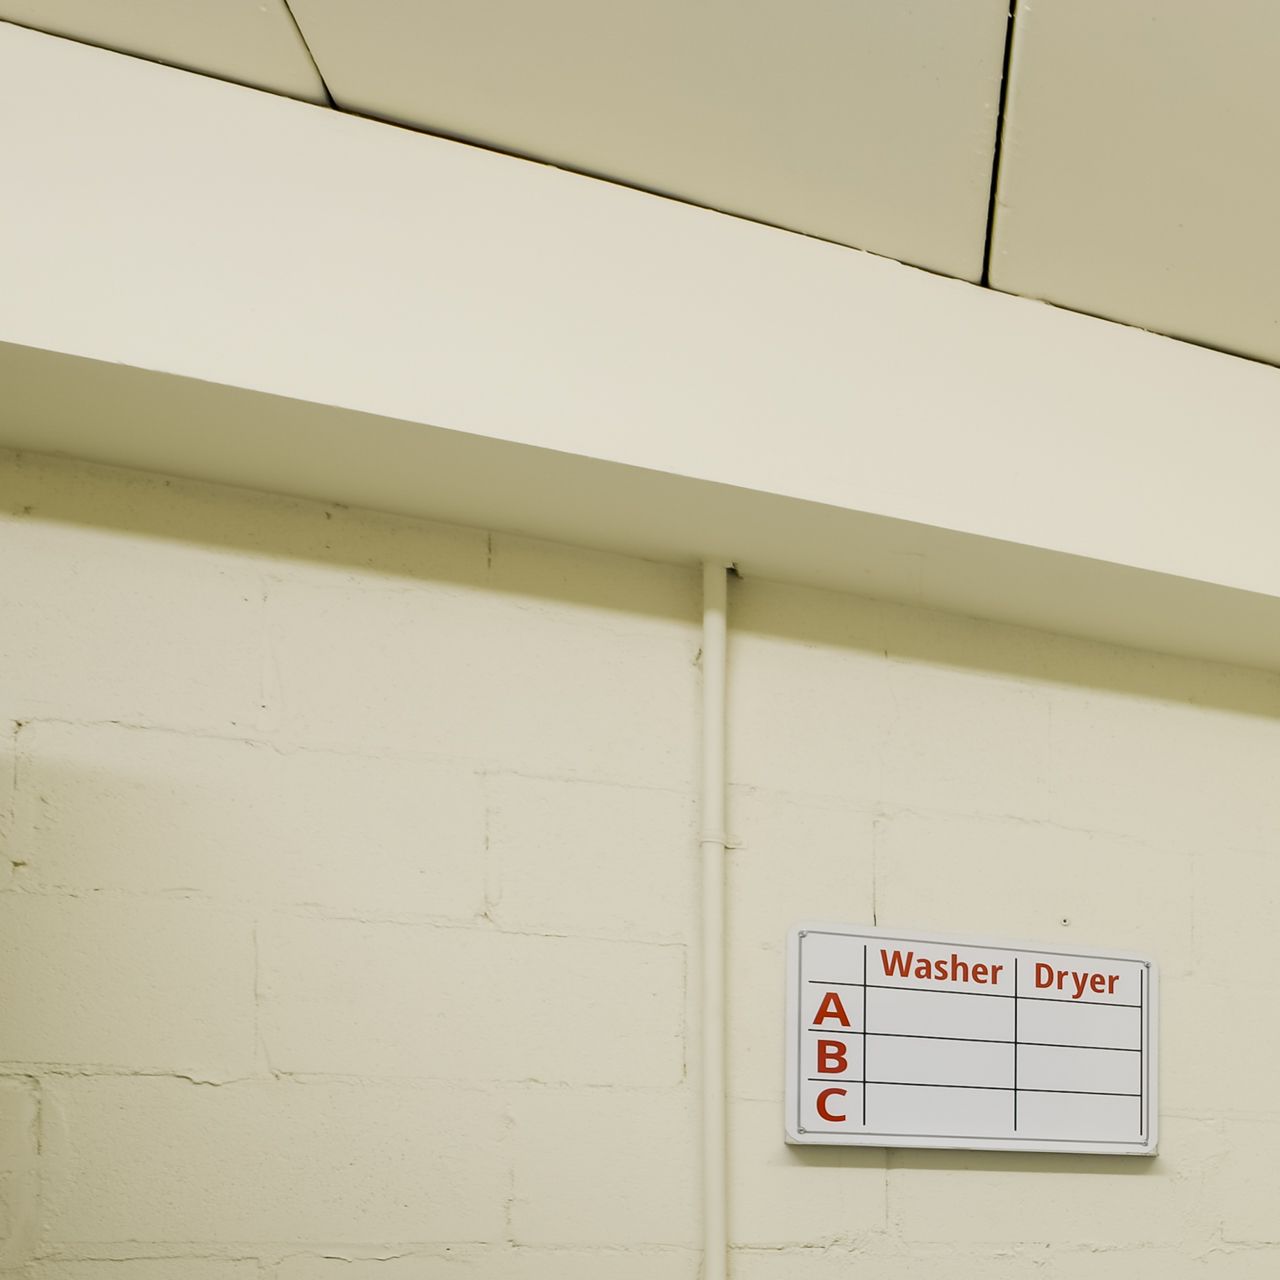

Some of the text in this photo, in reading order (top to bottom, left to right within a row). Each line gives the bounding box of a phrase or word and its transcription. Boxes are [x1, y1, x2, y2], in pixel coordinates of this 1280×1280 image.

[880, 949, 1119, 999] Washer Dryer
[812, 992, 851, 1027] A
[816, 1039, 848, 1074] B
[815, 1087, 848, 1122] C
